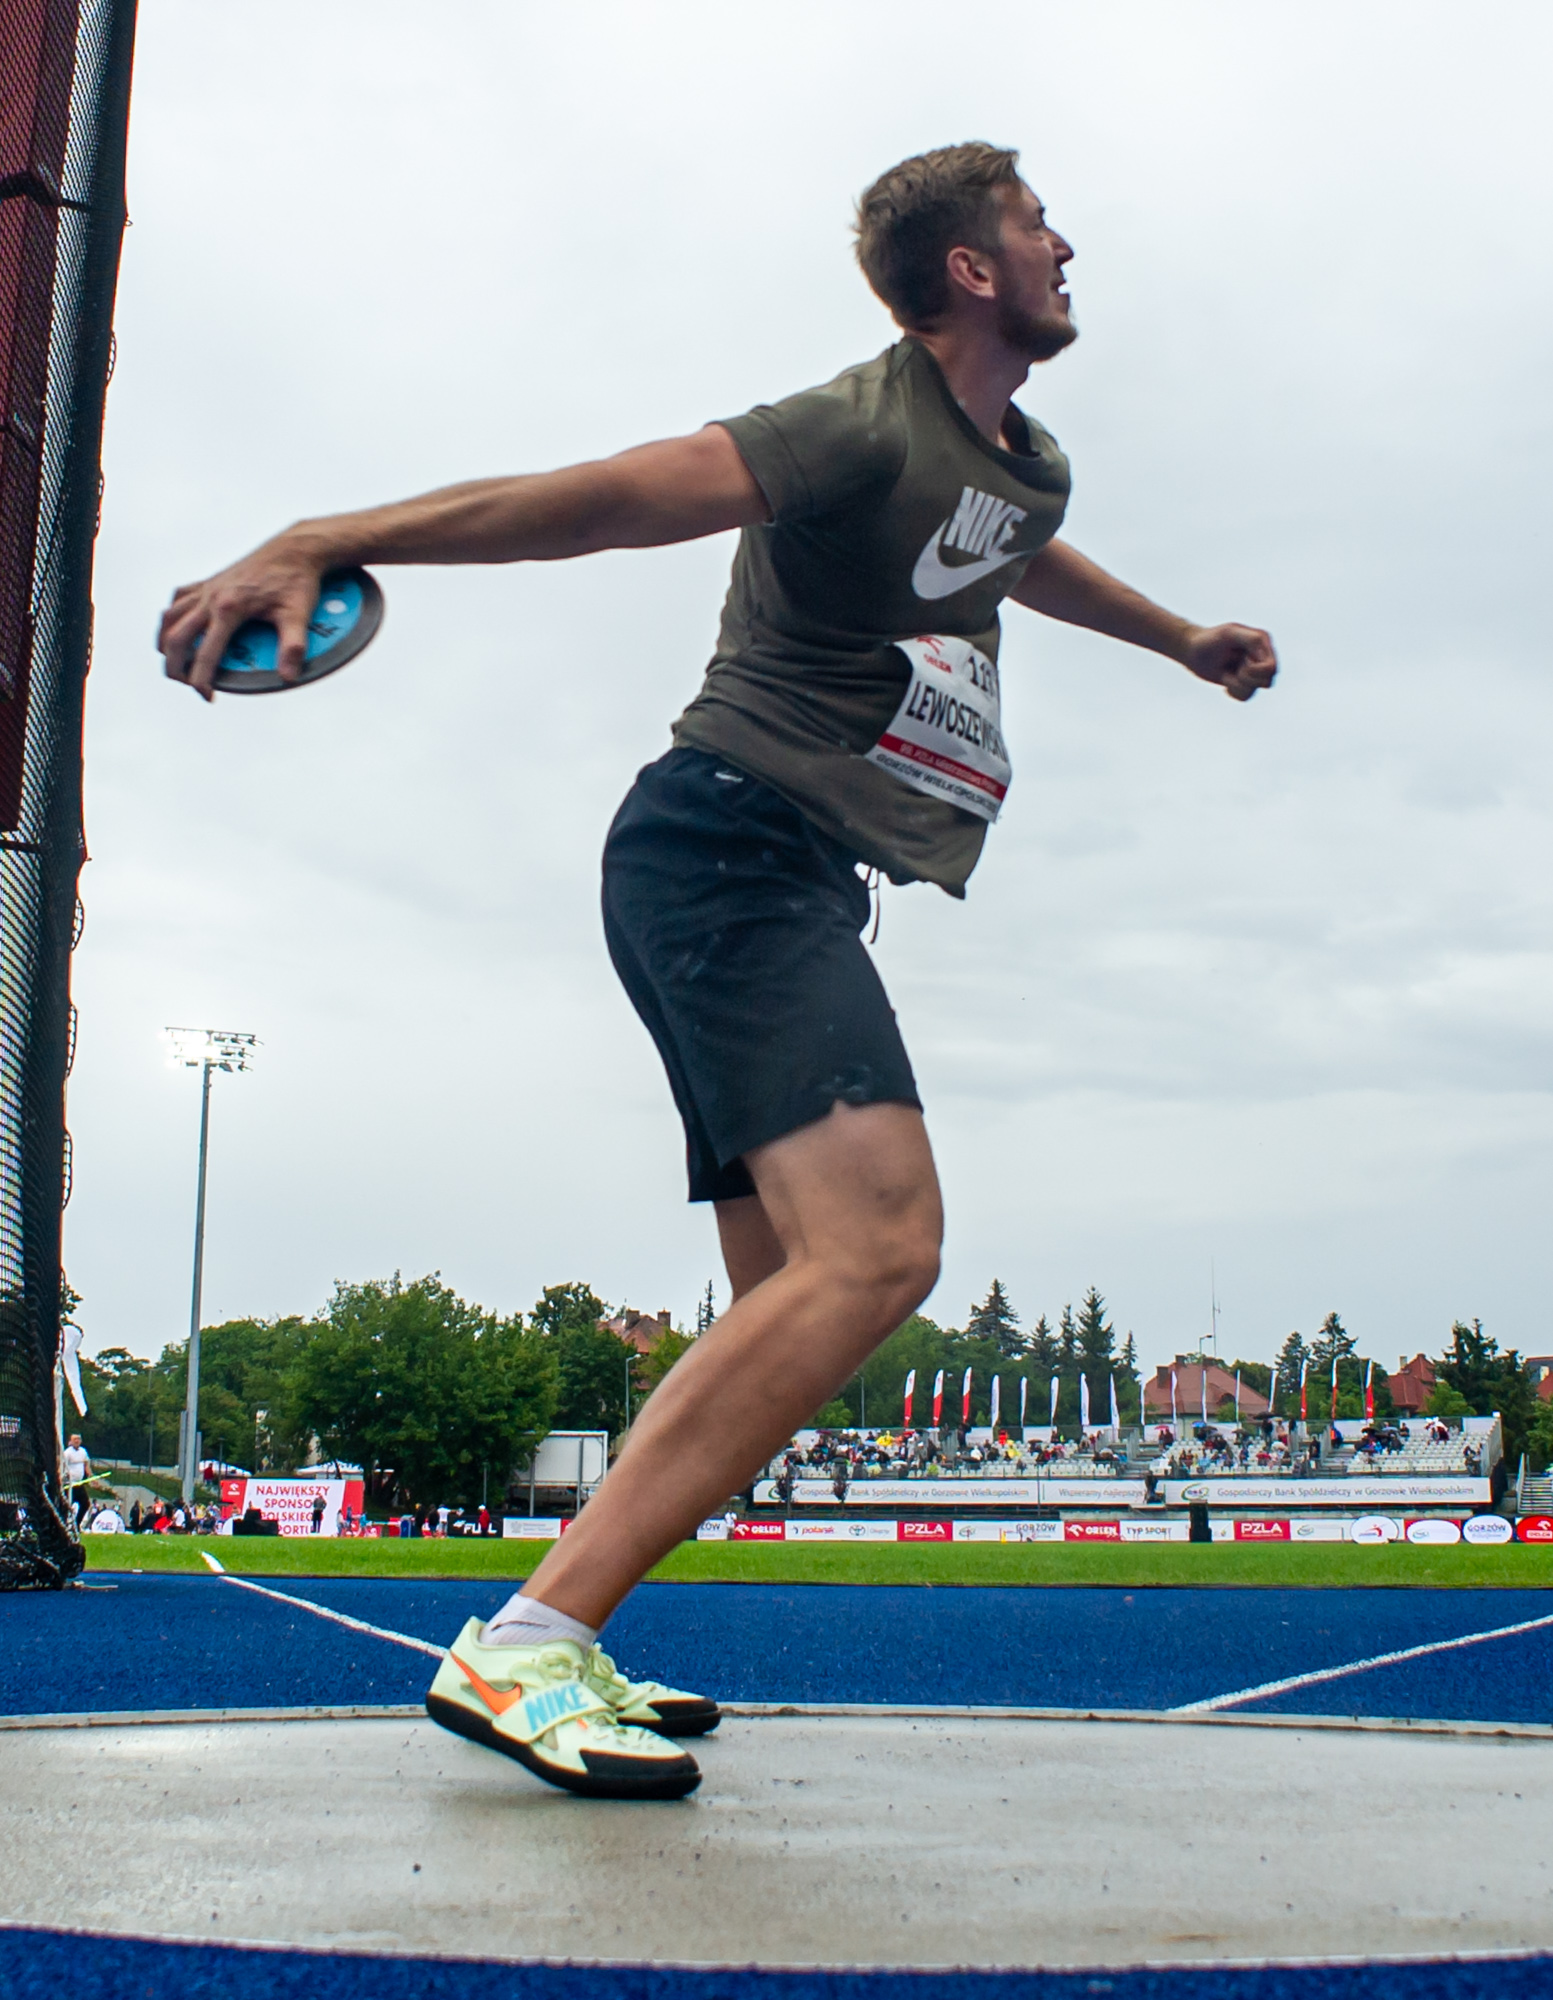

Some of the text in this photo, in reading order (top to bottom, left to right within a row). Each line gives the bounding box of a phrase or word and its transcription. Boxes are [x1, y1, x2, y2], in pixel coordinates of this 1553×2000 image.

[942, 486, 1028, 561] NIKE
[256, 1485, 330, 1498] NAJWIĘKSZY
[1217, 1487, 1272, 1498] Gospodarczy
[1275, 1488, 1296, 1497] Bank
[1409, 1486, 1474, 1497] Wielkopolskim
[264, 1498, 314, 1509] SPONSO
[261, 1511, 323, 1522] POLSKIEG
[463, 1522, 497, 1534] FUL
[751, 1525, 782, 1534] ORLEN
[904, 1523, 946, 1534] PZLA
[1015, 1522, 1056, 1532] GORZÓW
[1085, 1525, 1118, 1536] ORLEN
[1145, 1526, 1172, 1535] SPORT
[1241, 1522, 1283, 1533] PZLA
[1467, 1523, 1506, 1532] GORZÓW
[524, 1682, 588, 1733] NIKE
